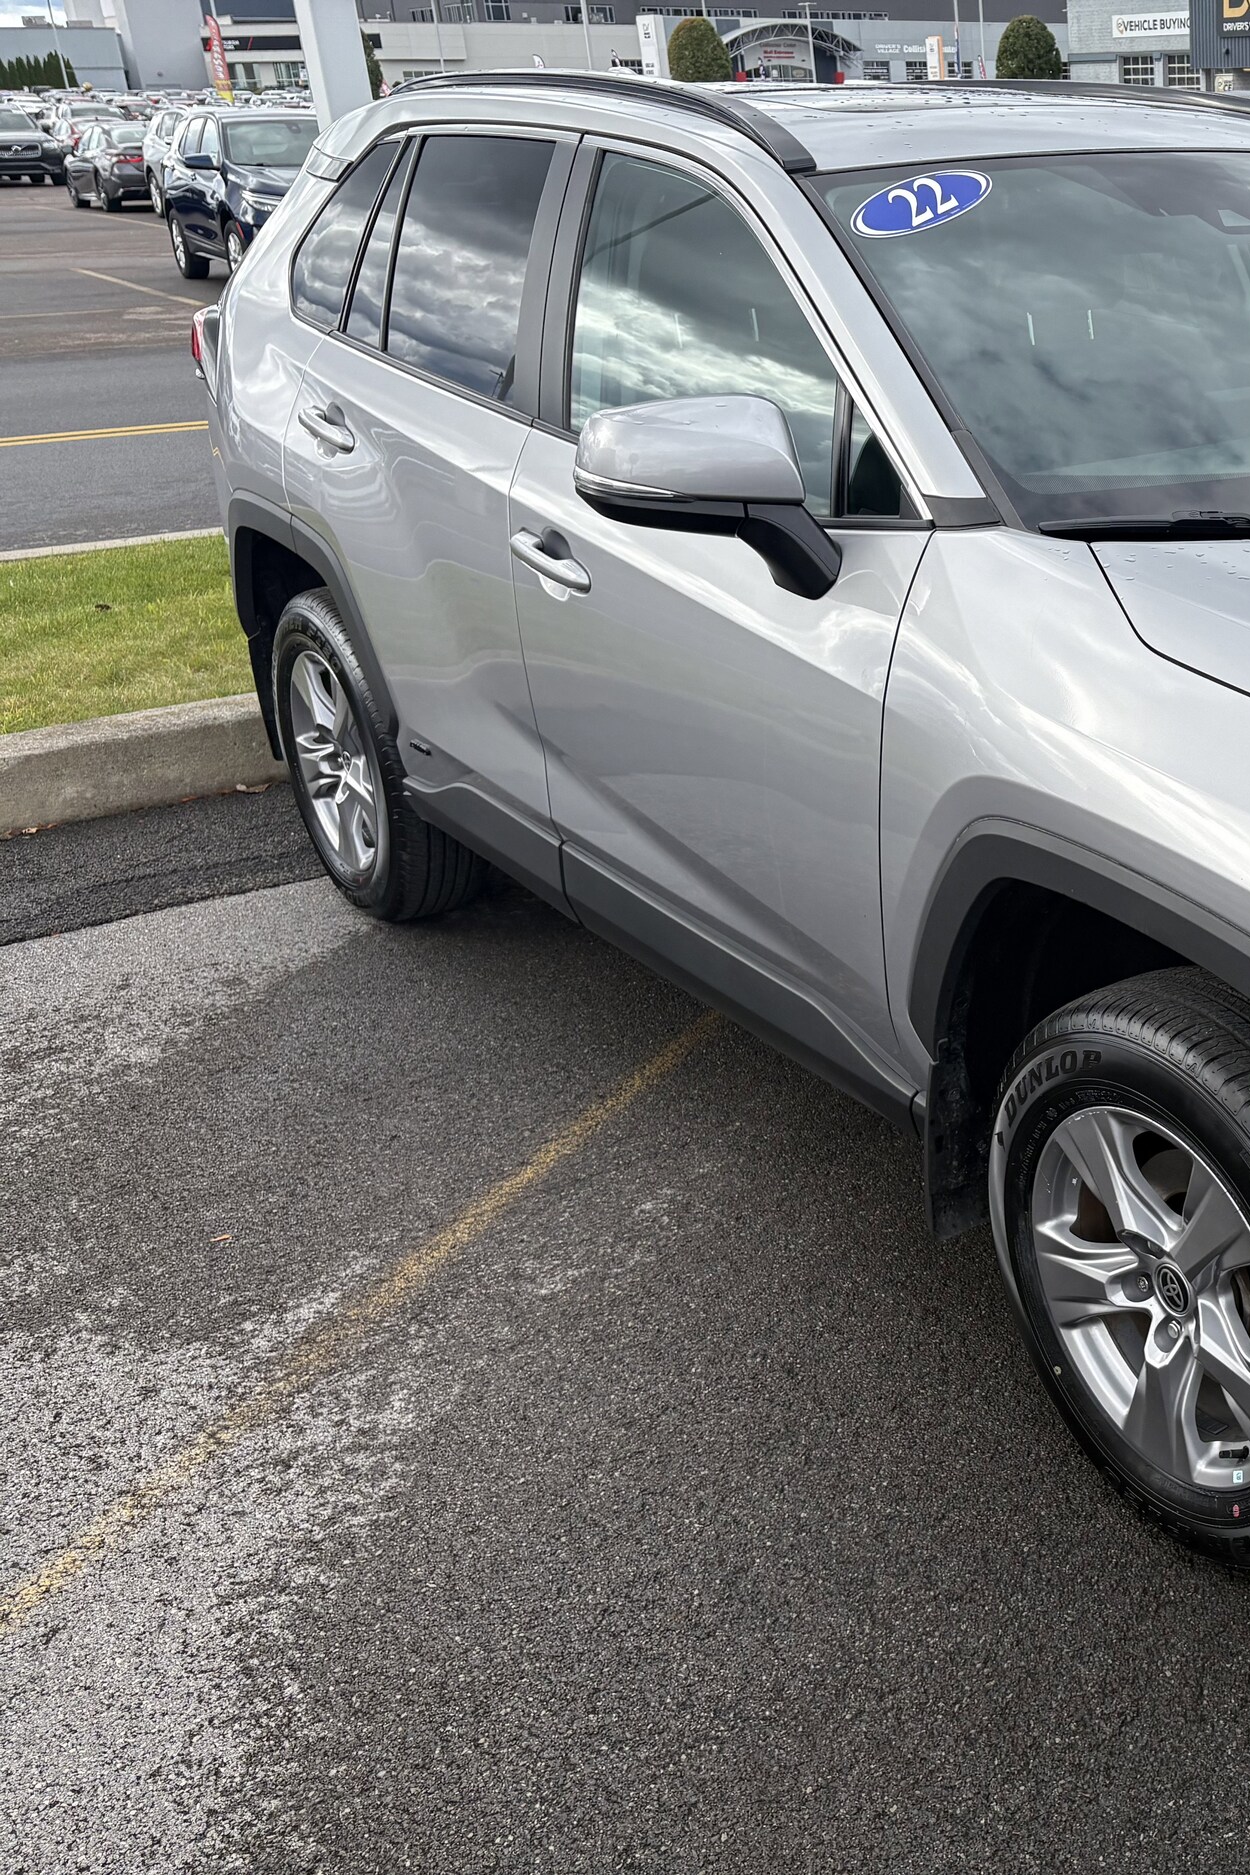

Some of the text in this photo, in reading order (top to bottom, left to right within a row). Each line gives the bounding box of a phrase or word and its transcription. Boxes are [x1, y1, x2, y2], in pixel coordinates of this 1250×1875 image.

[1123, 19, 1158, 32] VEHICLE
[1223, 22, 1248, 31] DRIVER'S
[903, 44, 926, 53] Collisi
[887, 177, 960, 228] 22
[1004, 1049, 1103, 1128] DUNLOP
